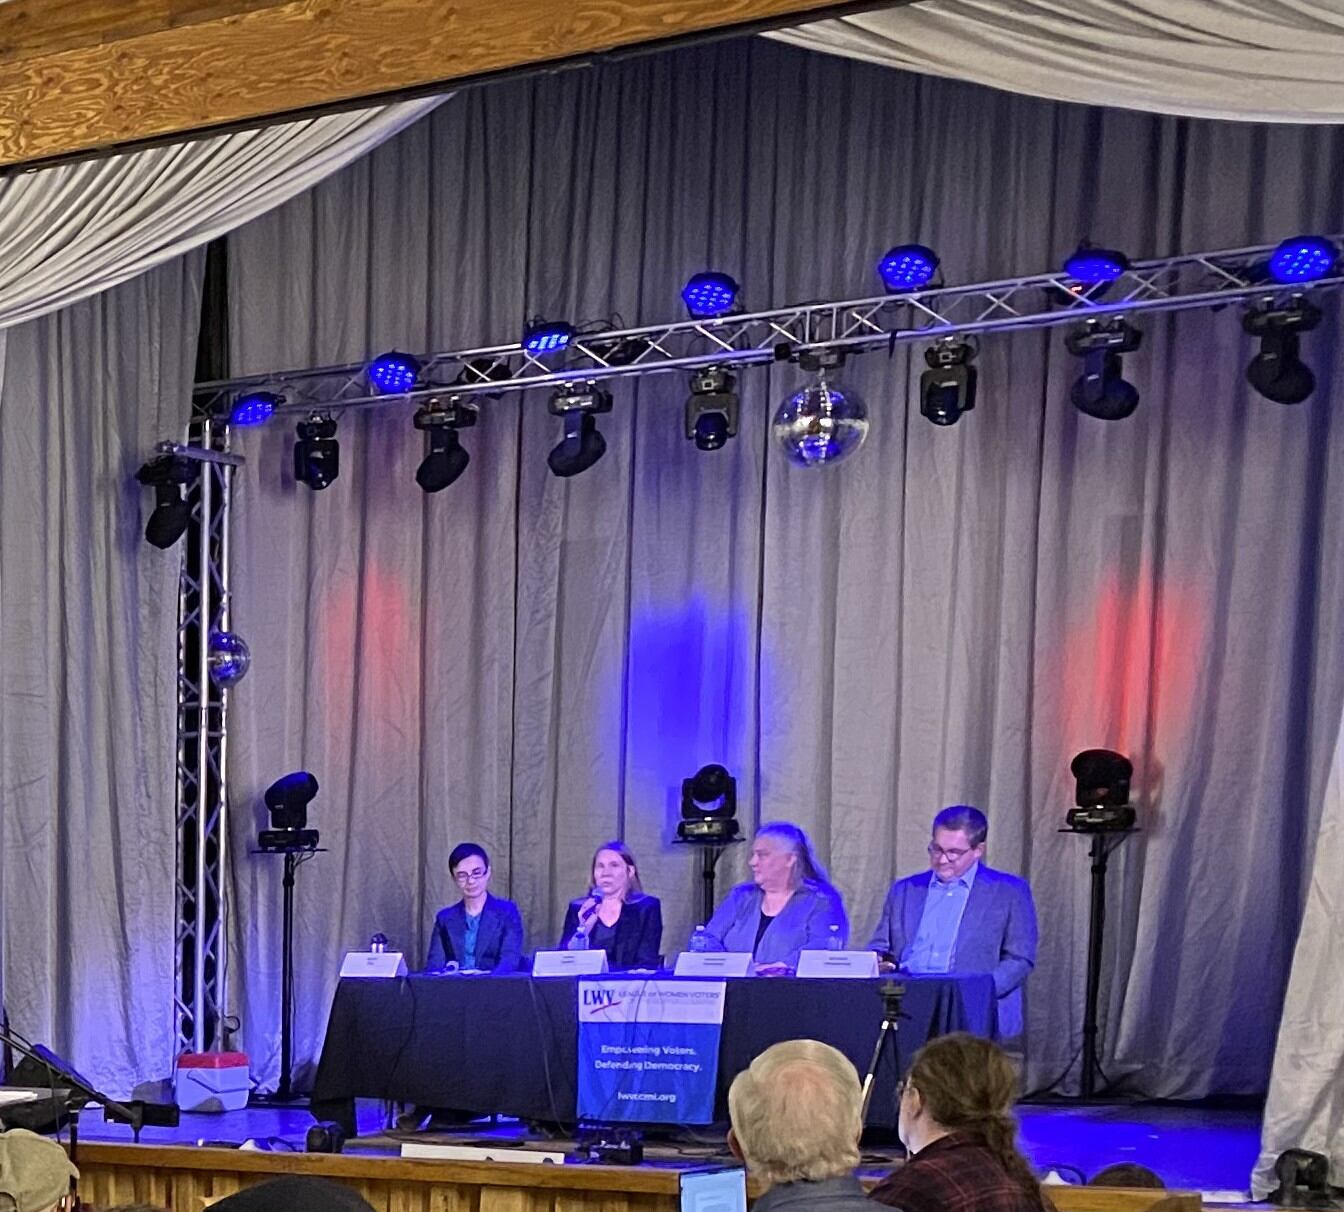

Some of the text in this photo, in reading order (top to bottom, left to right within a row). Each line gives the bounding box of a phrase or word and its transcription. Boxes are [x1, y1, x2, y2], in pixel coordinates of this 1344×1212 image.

[583, 989, 615, 1005] LWV
[595, 1060, 703, 1073] Defending Democracy.
